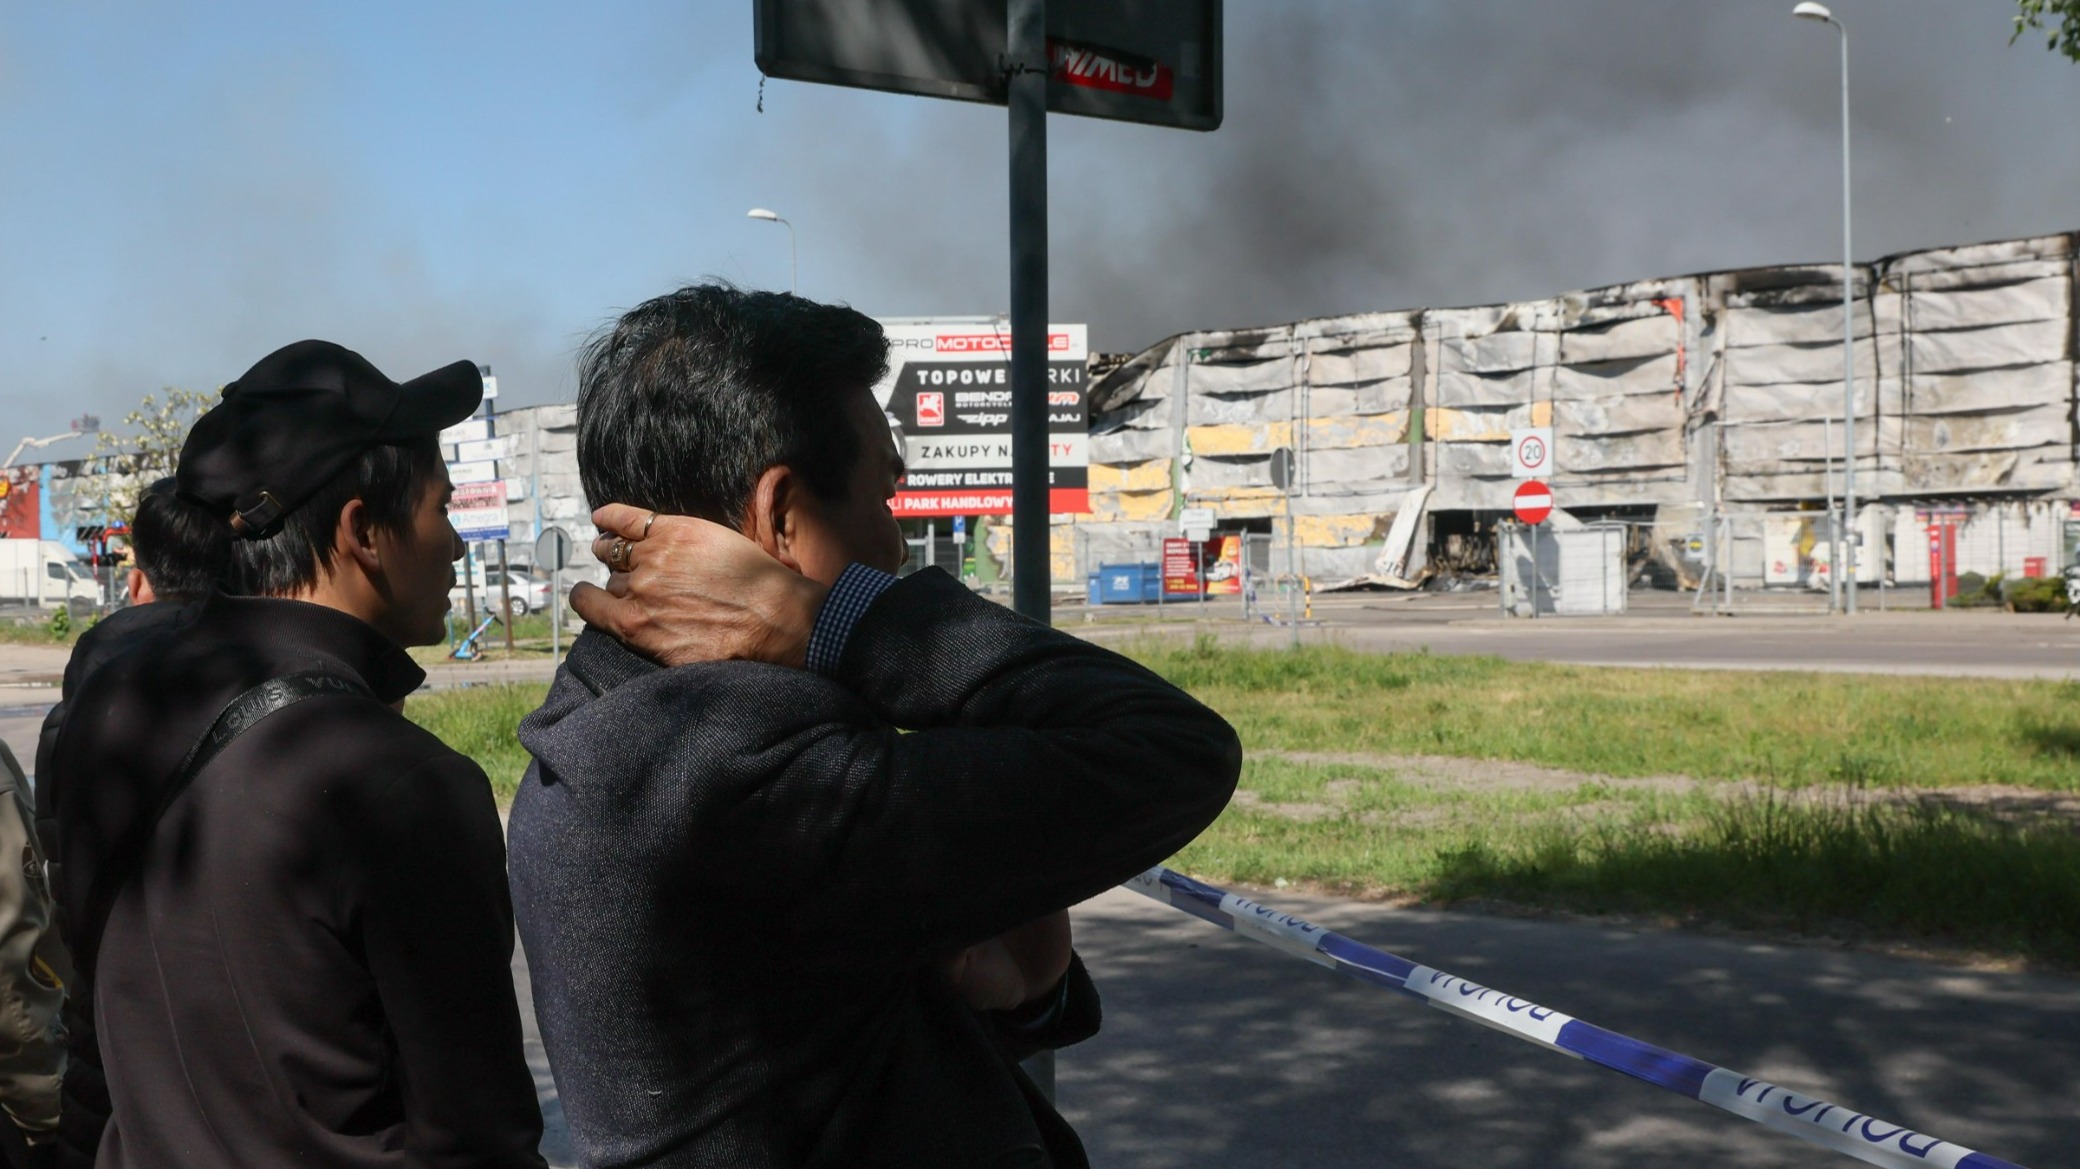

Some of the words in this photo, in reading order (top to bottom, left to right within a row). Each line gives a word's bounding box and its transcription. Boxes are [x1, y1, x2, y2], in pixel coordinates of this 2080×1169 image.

[917, 369, 1006, 385] TOPOWE
[1048, 368, 1080, 384] RKI
[1049, 413, 1081, 423] AJAJ
[921, 445, 991, 458] ZAKUPY
[998, 444, 1012, 457] N
[1051, 443, 1072, 457] TY
[1525, 445, 1542, 460] 20
[907, 473, 963, 486] ROWERY
[905, 497, 940, 510] PARK
[941, 496, 1013, 509] HANDLOWY
